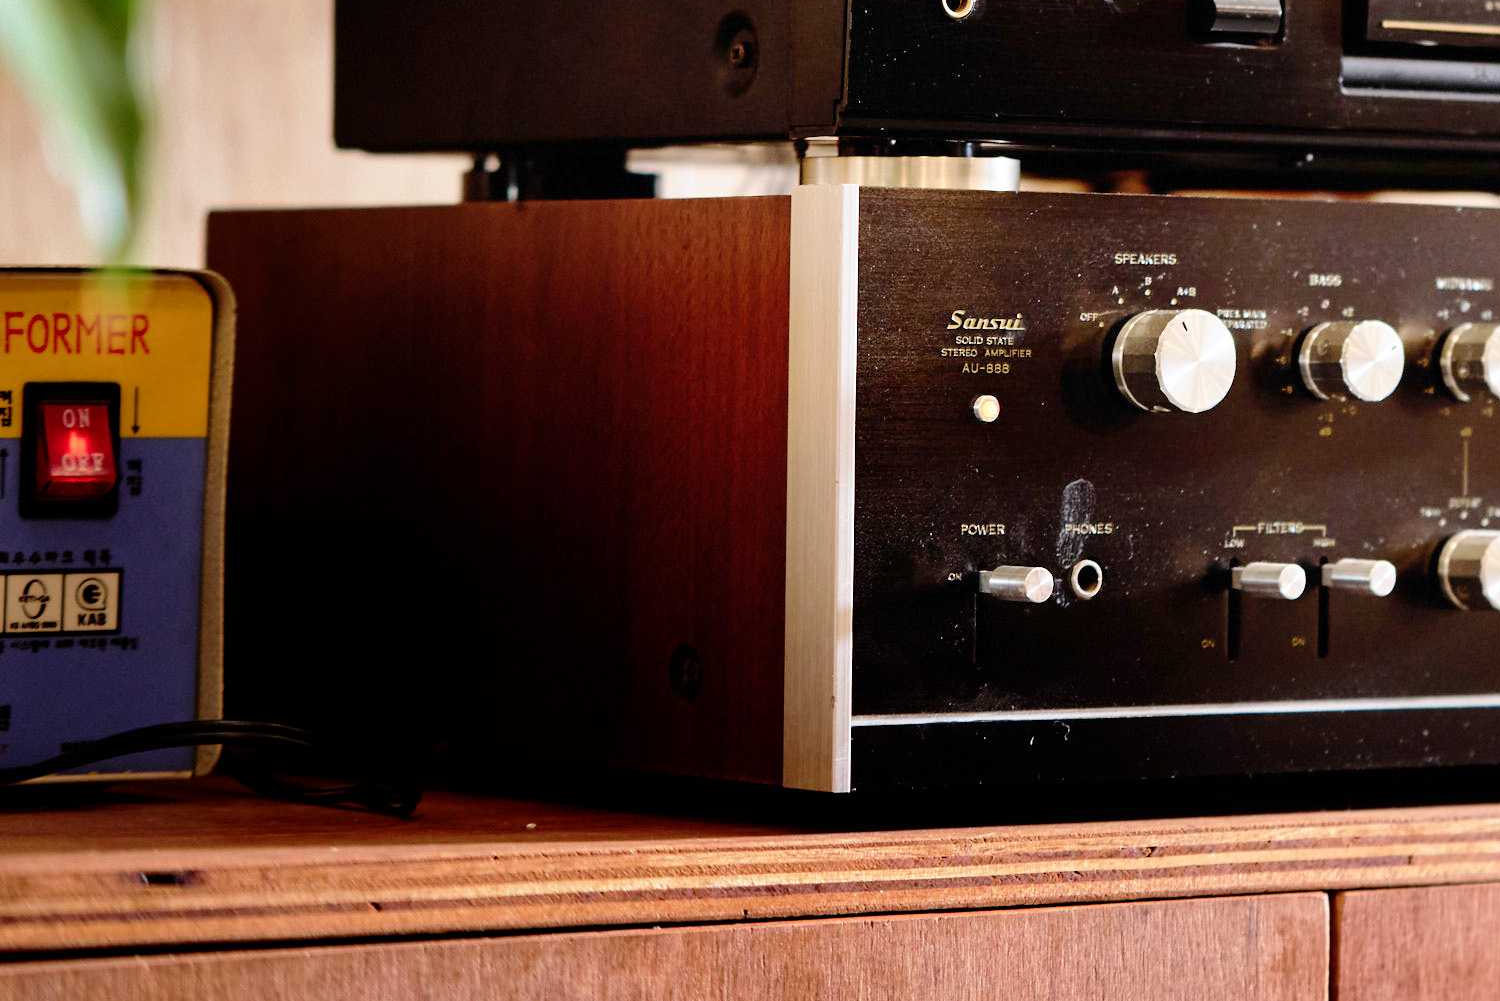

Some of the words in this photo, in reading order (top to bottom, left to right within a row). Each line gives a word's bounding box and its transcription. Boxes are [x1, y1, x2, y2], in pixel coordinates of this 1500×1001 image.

[1114, 253, 1177, 265] SPEAKERS
[1309, 273, 1343, 287] BASS
[1112, 285, 1119, 295] A
[946, 310, 1025, 331] Sansui
[1080, 312, 1098, 322] OFF
[4, 311, 150, 355] FORMER
[955, 336, 983, 345] SOLID
[986, 336, 1014, 346] STATE
[941, 348, 978, 358] STEREO
[984, 349, 1032, 358] AMPLIFIER
[962, 362, 1010, 374] AU-888
[62, 408, 90, 428] ON
[61, 453, 105, 472] OFF
[961, 523, 1006, 536] POWER
[1065, 523, 1113, 535] PHONES
[1257, 521, 1304, 534] FILTERS
[1224, 538, 1246, 548] LOW
[948, 573, 962, 582] ON
